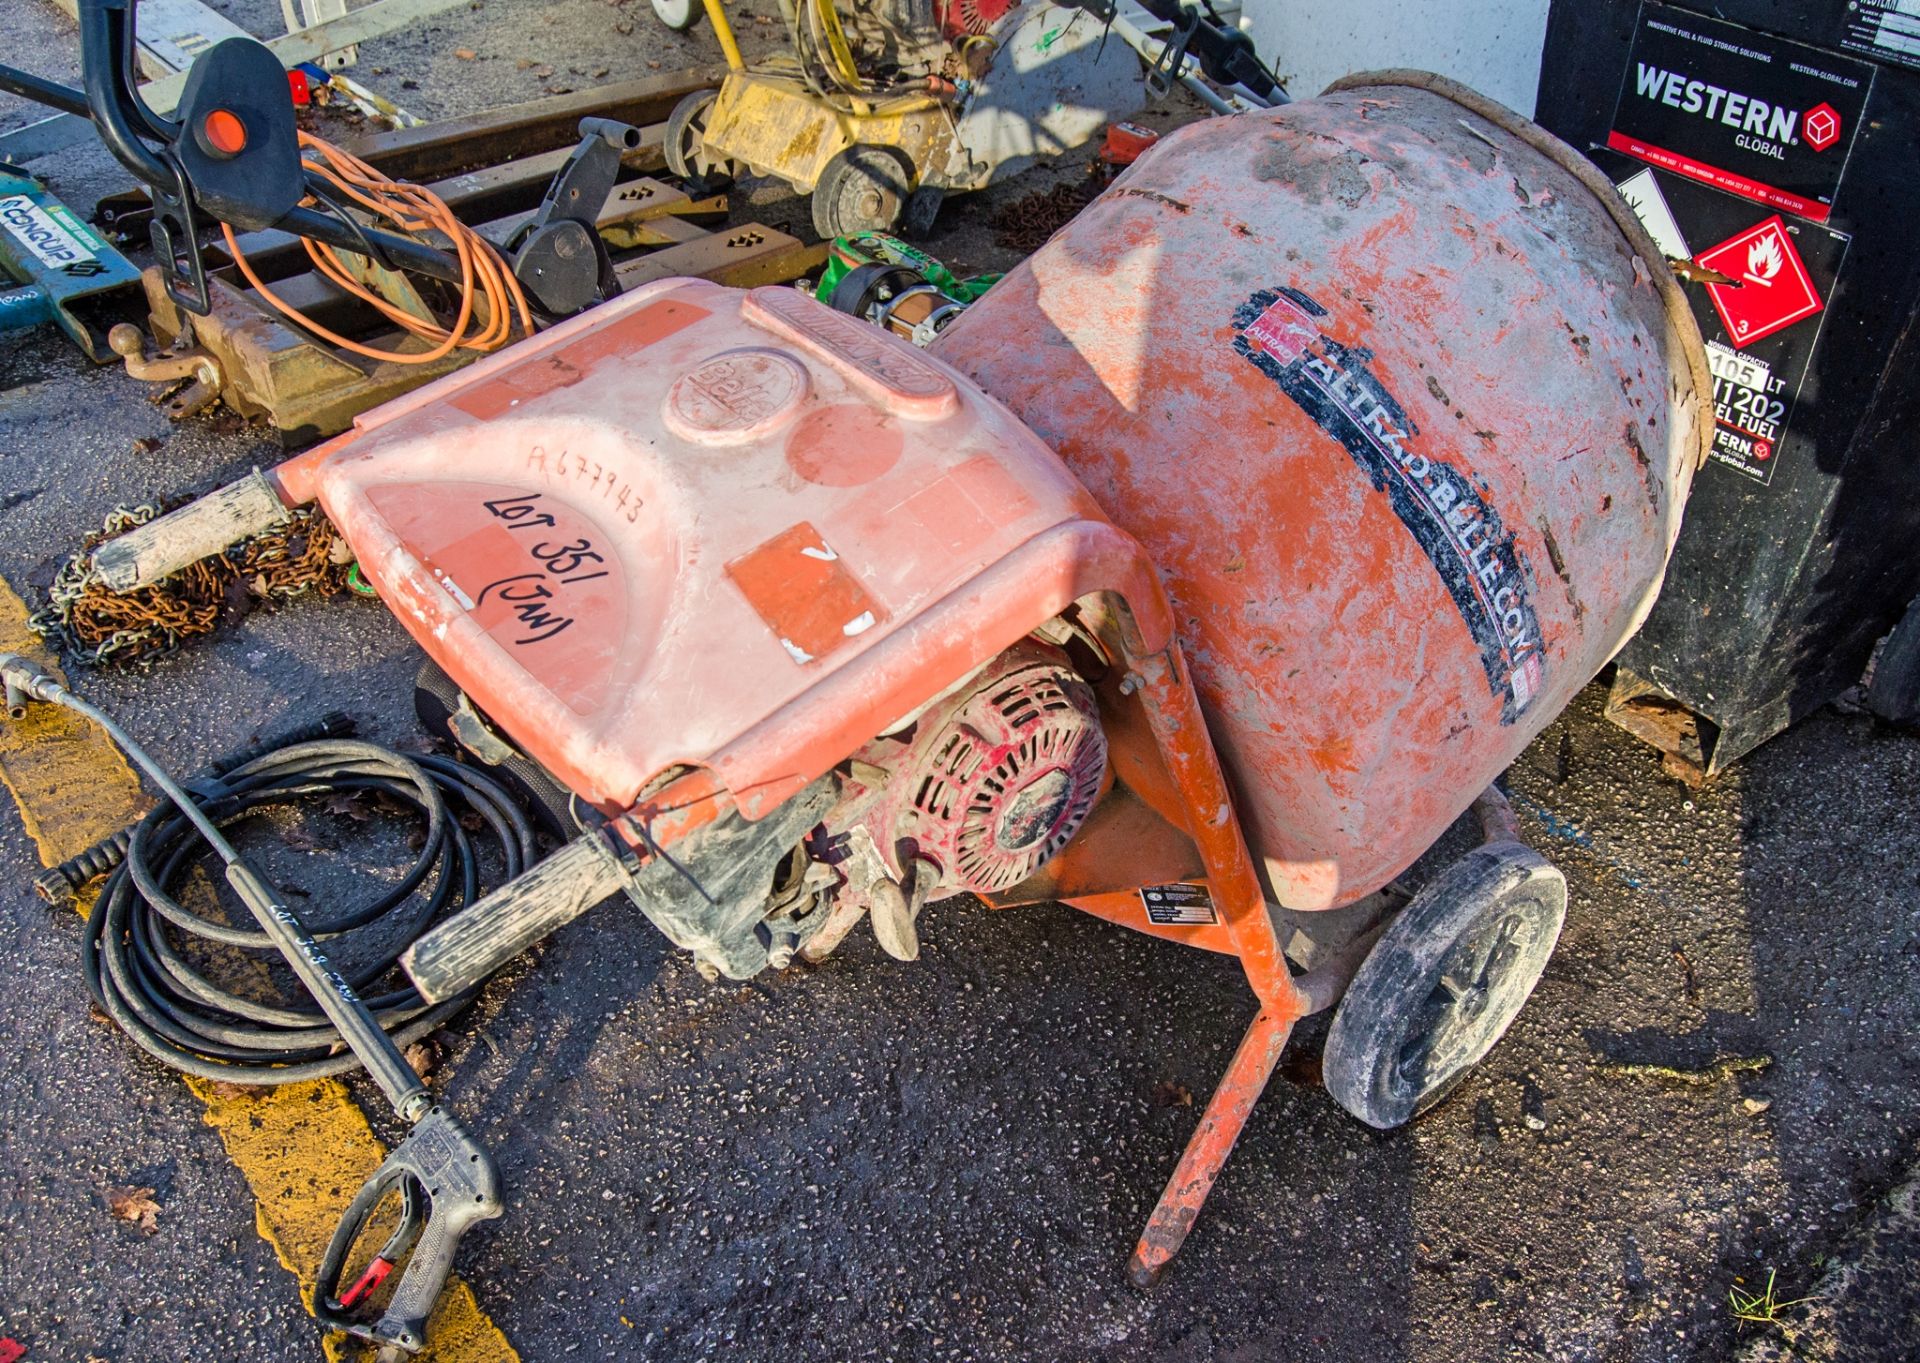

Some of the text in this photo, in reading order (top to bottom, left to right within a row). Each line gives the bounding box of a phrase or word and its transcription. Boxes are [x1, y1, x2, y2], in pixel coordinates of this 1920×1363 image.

[1647, 20, 1772, 63] INNOVATIVE FUEL & FLUID STORAGE SOLUTIONS
[1790, 62, 1858, 88] WESTERN-GLOBAL.COM
[1735, 134, 1785, 160] GLOBAL
[3, 208, 76, 261] CONQUIP
[1737, 319, 1749, 334] 3
[1708, 339, 1770, 369] NOMINAL CAPACITY
[1712, 354, 1786, 395] 105 LT
[1737, 412, 1776, 442] FUEL
[1710, 448, 1764, 478] rn-global.com
[483, 494, 609, 584] LOT 351
[269, 904, 299, 926] LOT
